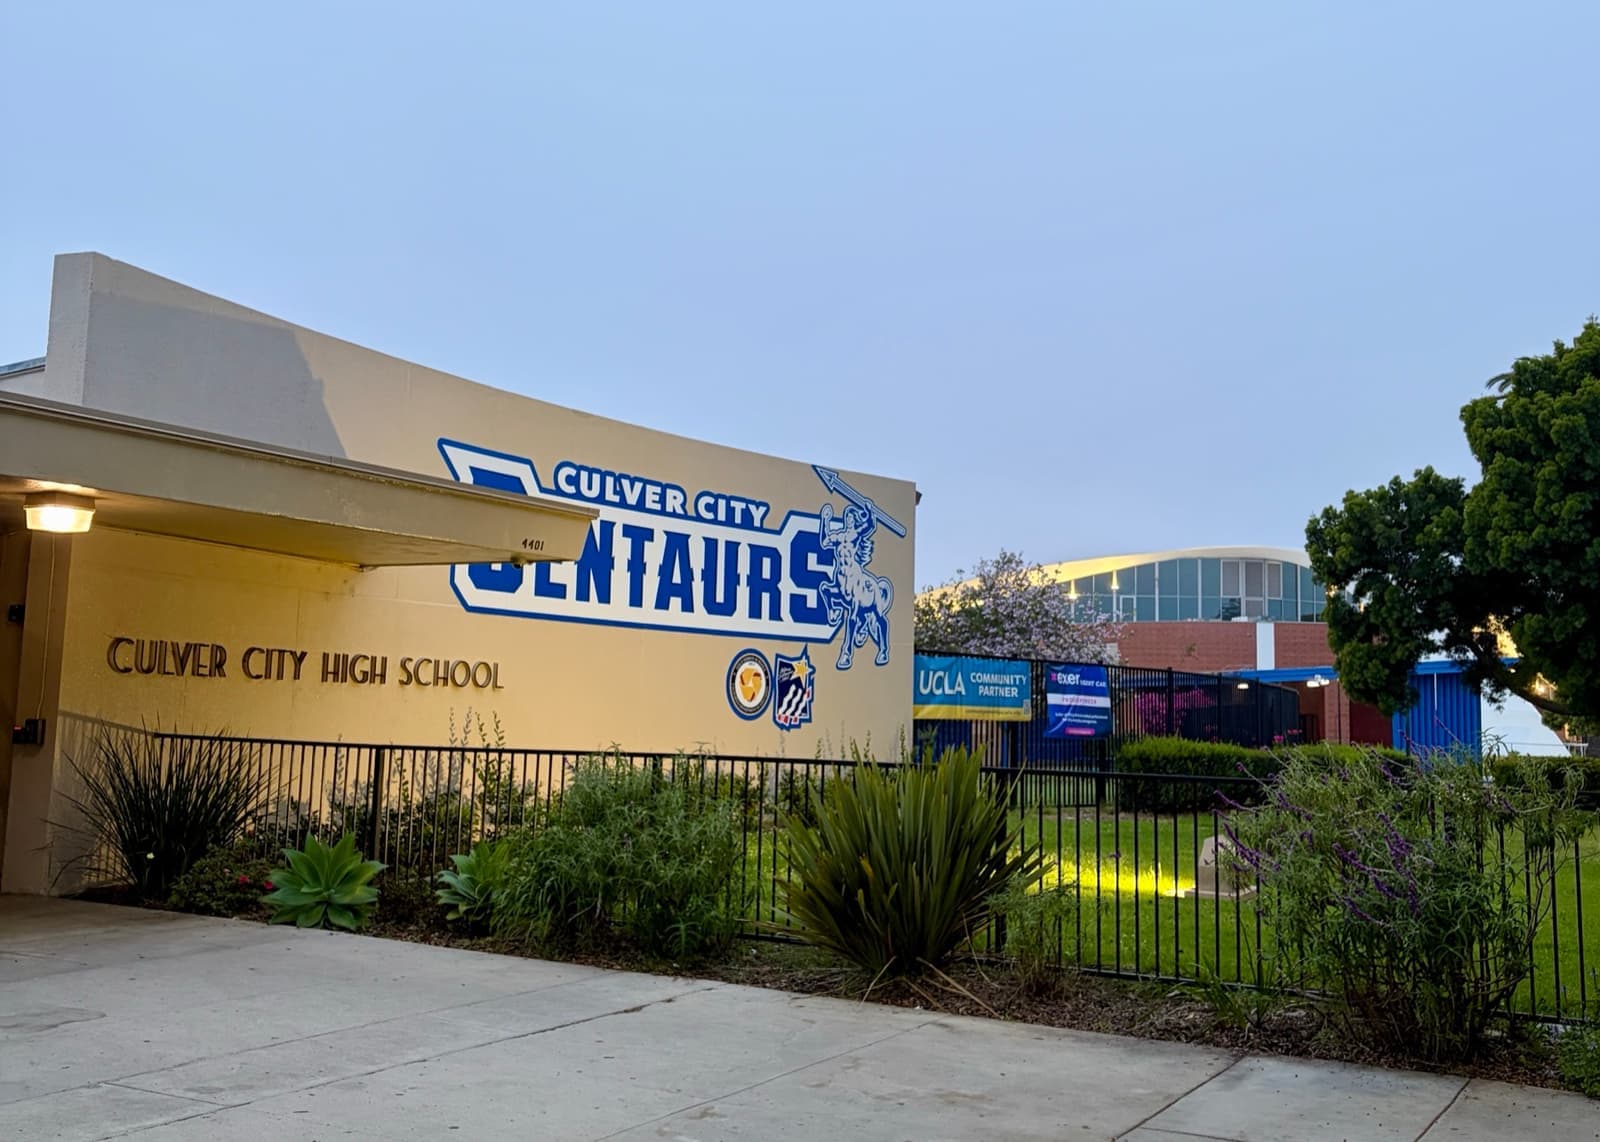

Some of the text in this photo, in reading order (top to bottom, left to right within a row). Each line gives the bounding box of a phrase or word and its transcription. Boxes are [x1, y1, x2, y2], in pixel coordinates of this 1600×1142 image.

[557, 466, 768, 529] CULVER CITY
[522, 538, 544, 551] 4401
[107, 637, 504, 690] CULVER CITY HIGH SCHOOL
[919, 670, 1027, 696] UCLA COMMUNITY
[1057, 672, 1080, 685] exer
[978, 685, 1018, 698] PARTNER
